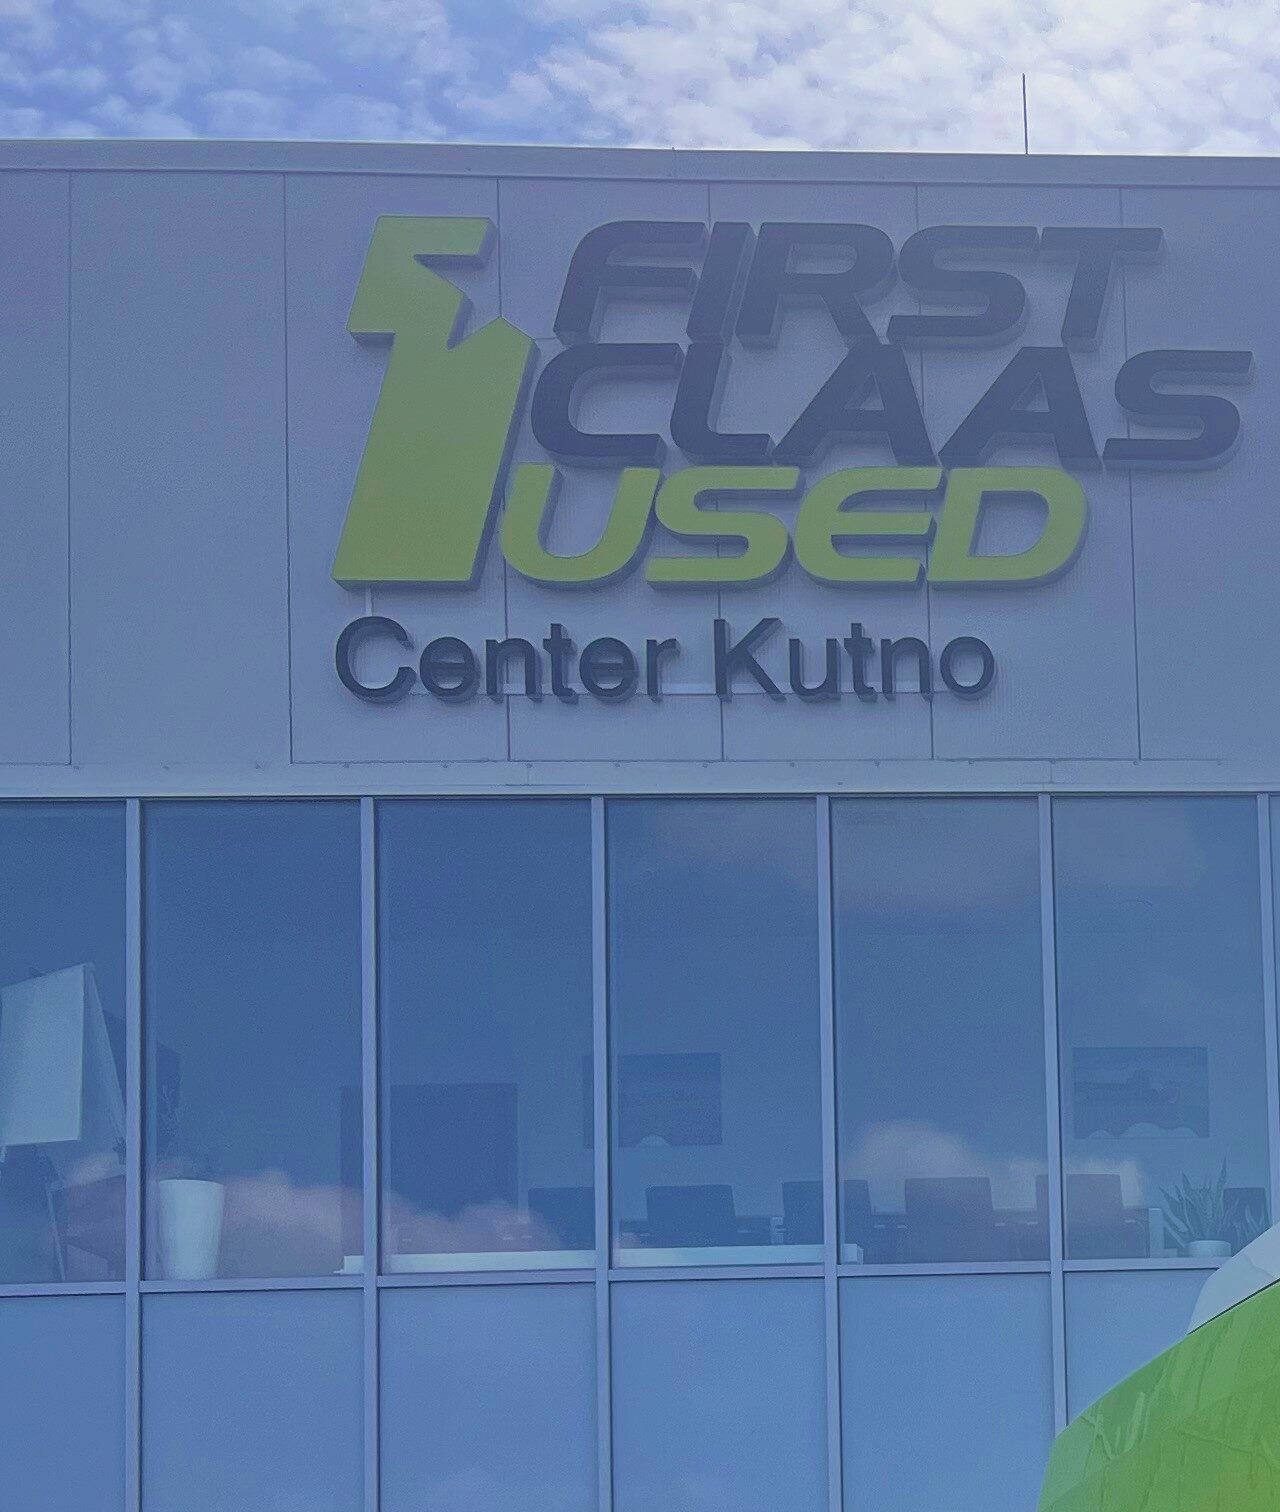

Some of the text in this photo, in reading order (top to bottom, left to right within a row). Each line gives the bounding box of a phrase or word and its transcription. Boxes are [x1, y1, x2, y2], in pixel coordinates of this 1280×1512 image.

[552, 221, 1167, 348] FIRST
[530, 341, 1256, 469] CLAAS
[498, 462, 1090, 589] USED
[334, 616, 998, 705] Center Kutno
